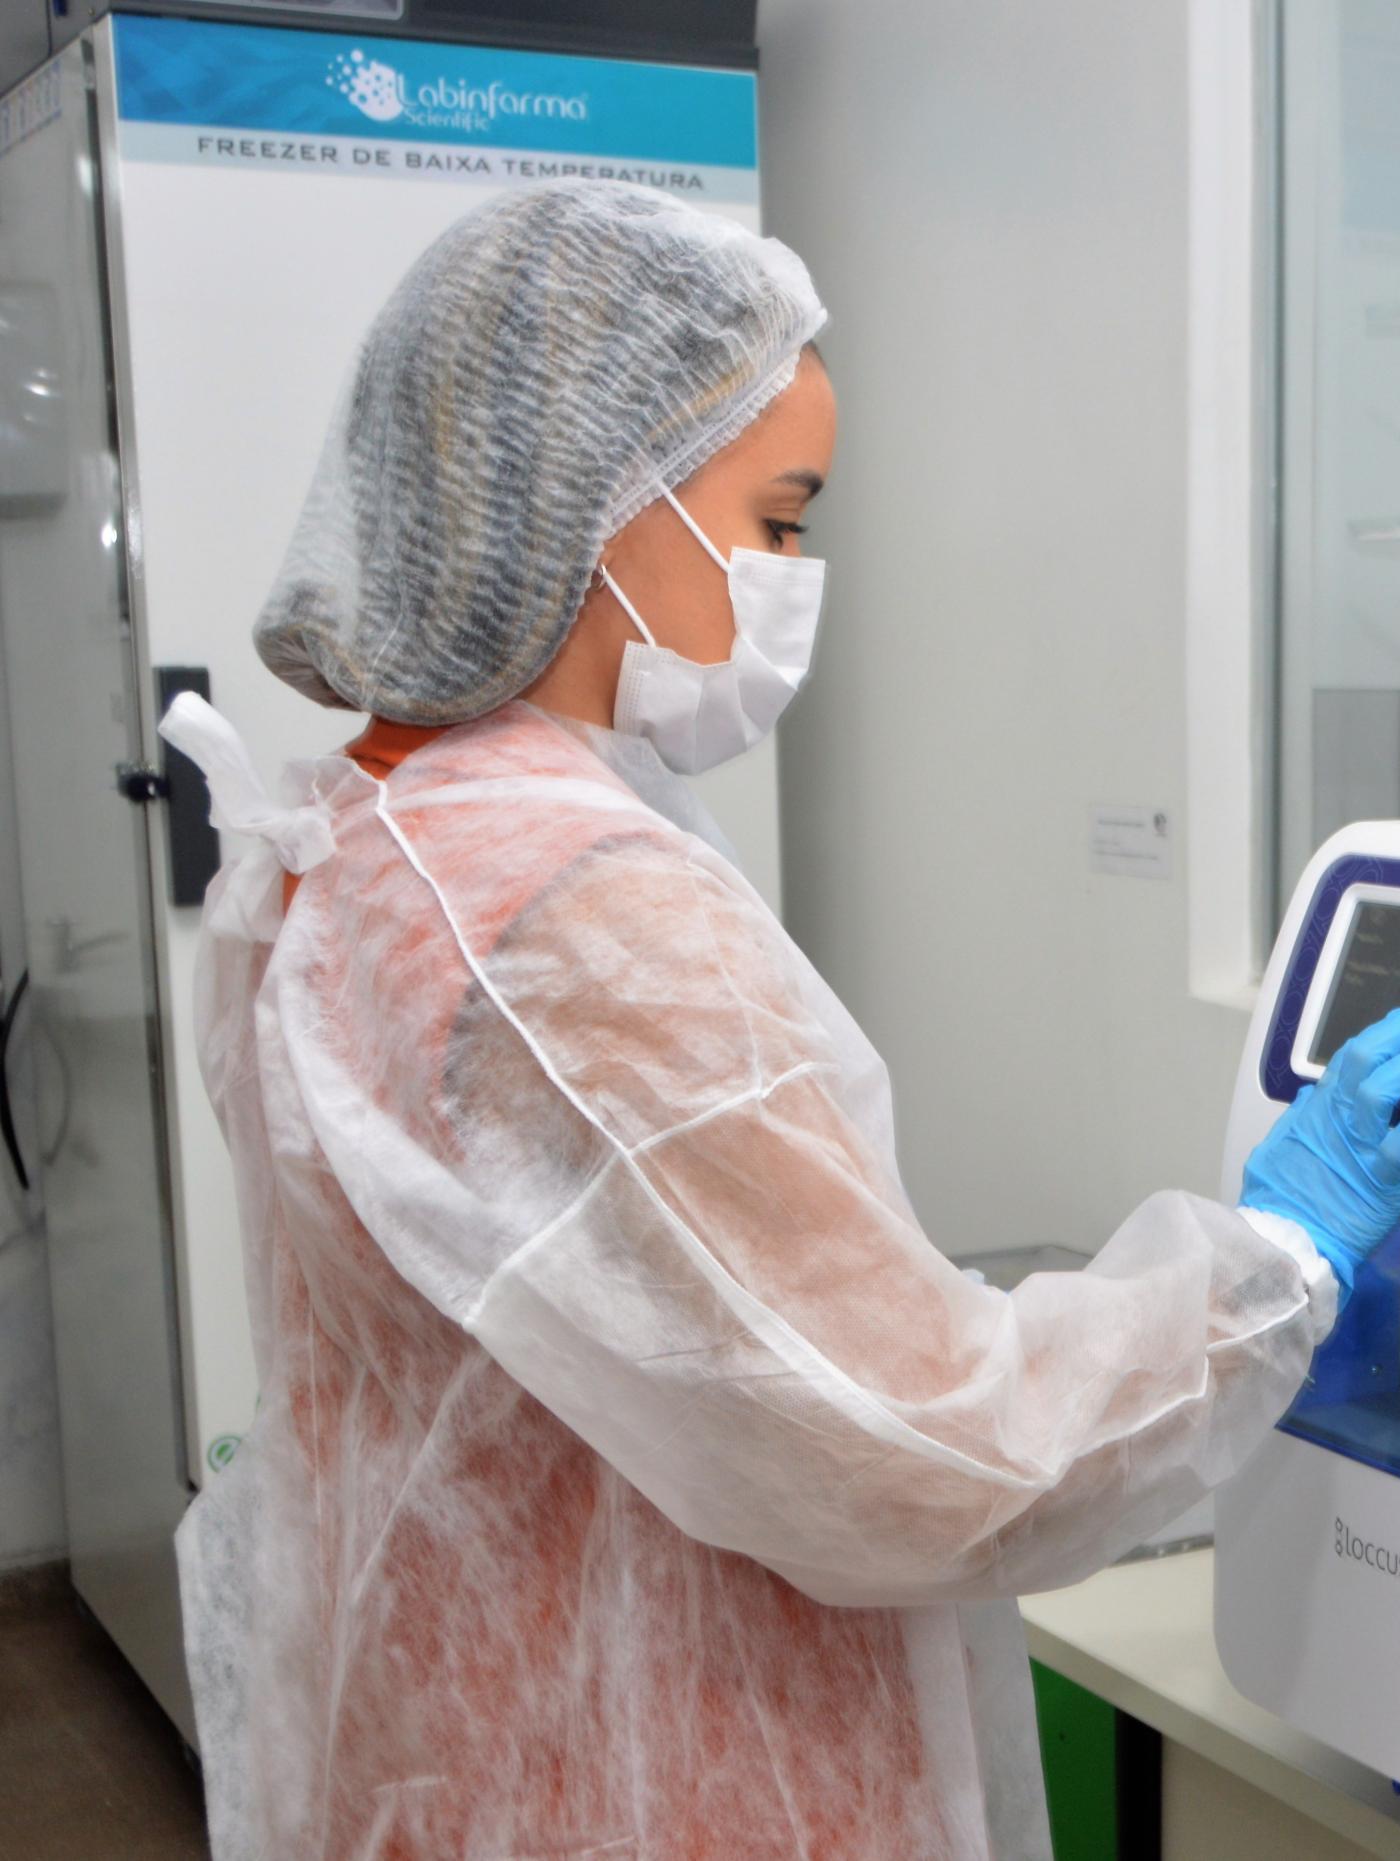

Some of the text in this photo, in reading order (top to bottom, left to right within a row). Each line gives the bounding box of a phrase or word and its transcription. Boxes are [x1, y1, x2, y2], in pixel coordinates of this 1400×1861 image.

[397, 73, 587, 120] Labinfarma
[403, 104, 490, 132] Scientific
[196, 136, 705, 190] FREEZER DE BAIXA TEMPERATURA
